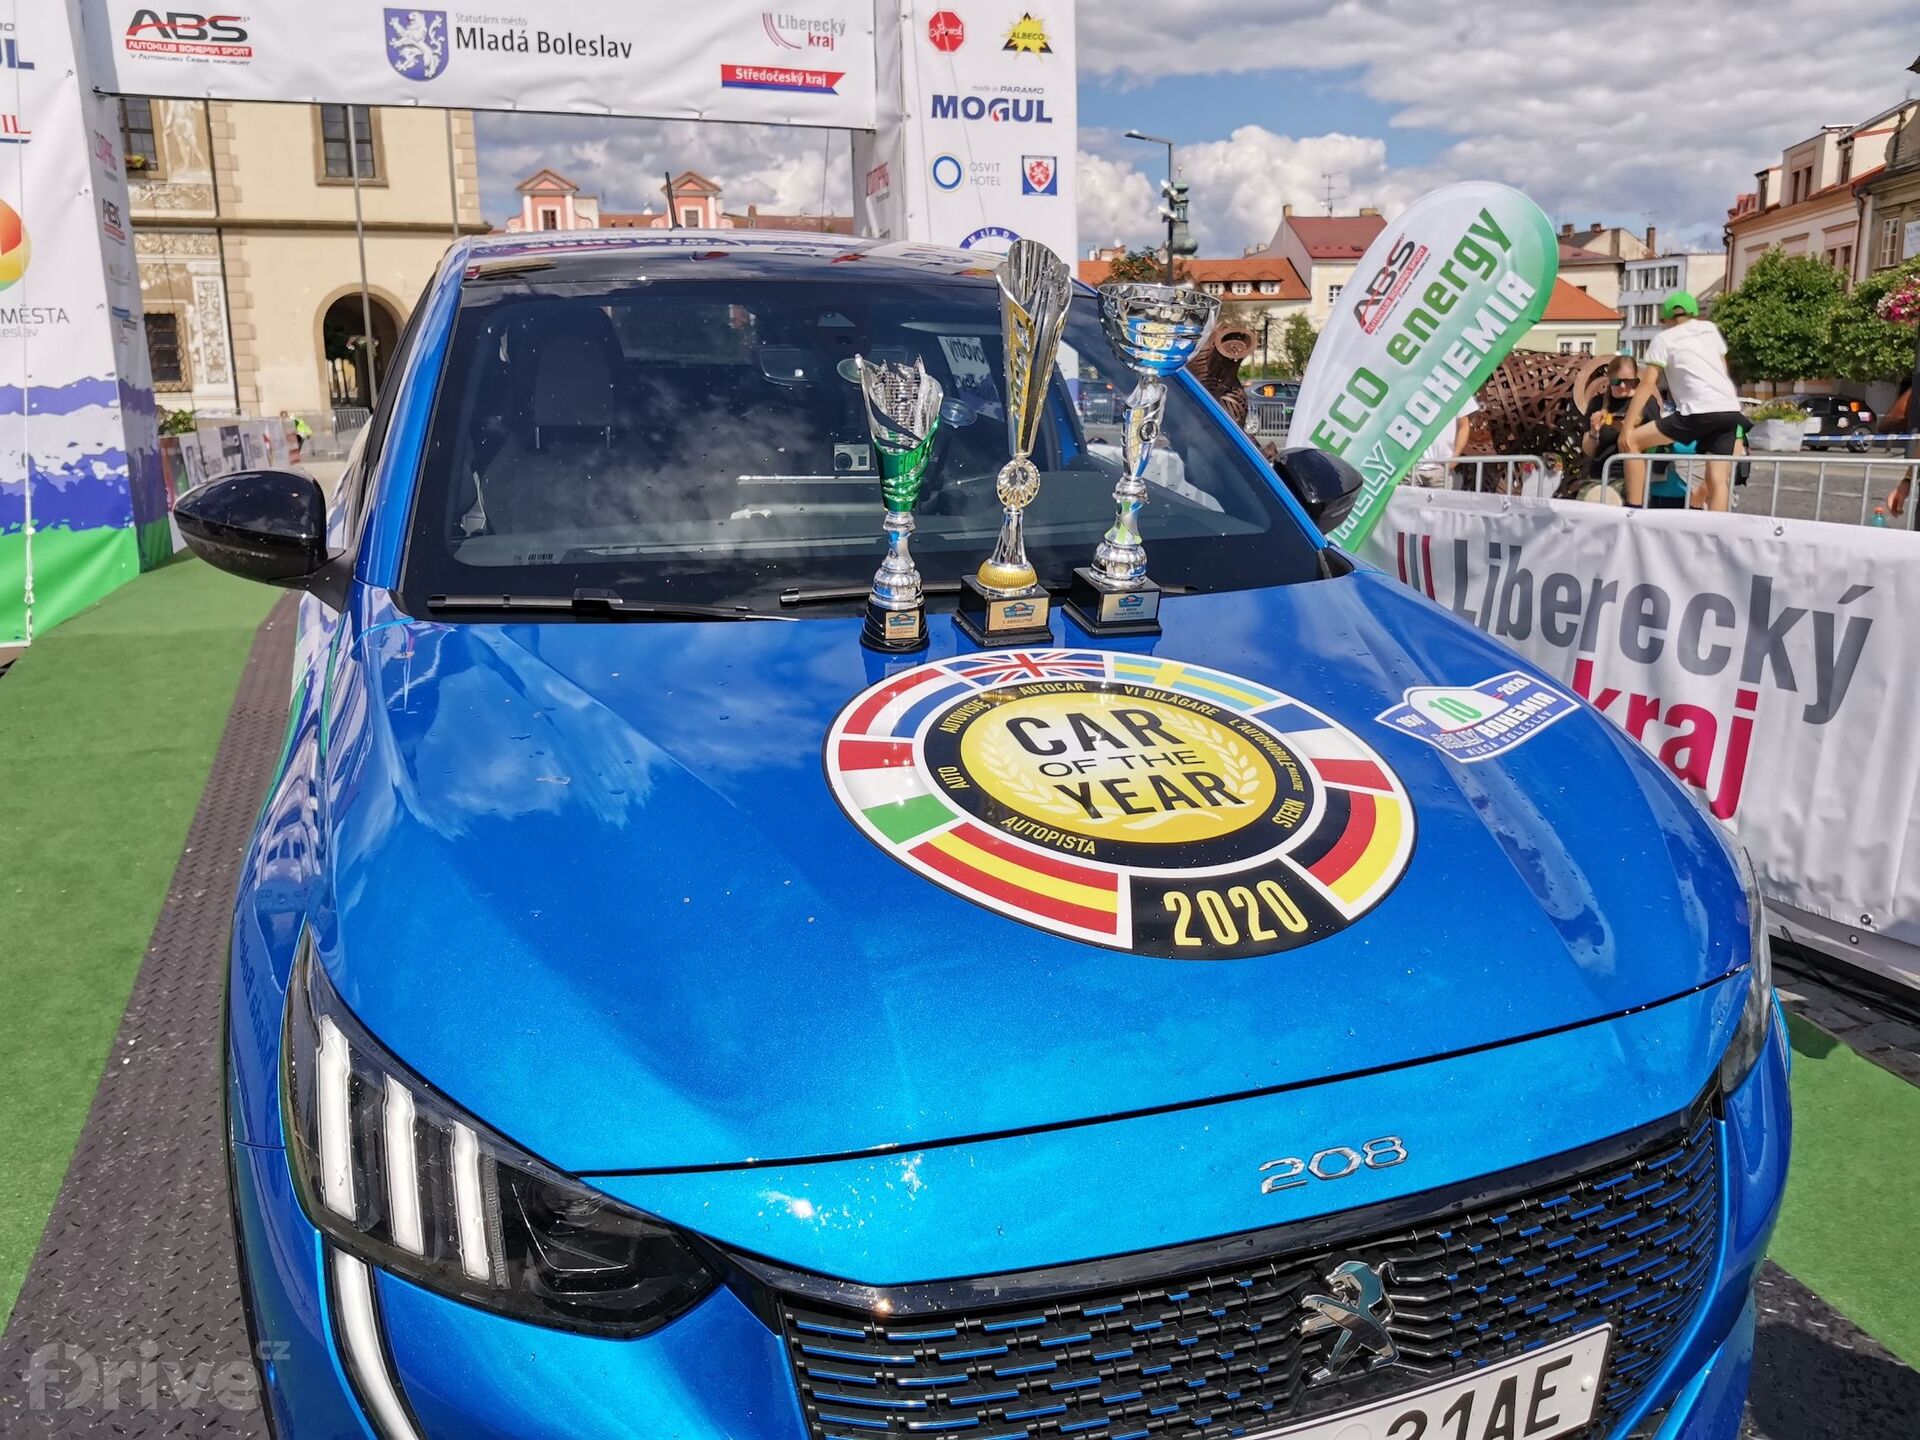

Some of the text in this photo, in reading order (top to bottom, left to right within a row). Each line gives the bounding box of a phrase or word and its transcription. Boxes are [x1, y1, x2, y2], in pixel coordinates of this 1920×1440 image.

[126, 9, 248, 42] ABS
[777, 14, 846, 37] Liberecký
[1011, 31, 1045, 41] ALBECO
[128, 41, 250, 57] AUTOKLUB BOHEMIA SPORT
[456, 26, 632, 59] Mladá Boleslav
[808, 32, 834, 52] kraj
[735, 68, 827, 88] Středočeský kraj
[1000, 86, 1044, 94] PARAMO
[931, 94, 1053, 123] MOGUL
[969, 162, 1001, 173] OSVIT
[970, 176, 1002, 187] HOTEL
[967, 229, 1022, 244] MLAD
[1354, 241, 1415, 329] ABS
[0, 303, 70, 325] MĚSTA
[1309, 367, 1389, 457] ECO
[1387, 208, 1512, 365] energy
[1385, 270, 1536, 451] BOHEMIA
[1453, 539, 1874, 725] Liberecký
[1018, 682, 1086, 696] AUTOCAR
[1124, 685, 1221, 716] VI BILÄGARE
[1497, 677, 1531, 696] 2020
[1428, 697, 1482, 723] 10
[1477, 691, 1557, 738] BOHEMIA
[1006, 708, 1186, 756] CAR
[1572, 658, 1759, 821] kraj
[938, 766, 971, 790] AUTO
[1039, 750, 1205, 777] OF THE
[1053, 771, 1246, 820] YEAR
[1272, 798, 1305, 829] STERN
[1000, 815, 1097, 855] AUTOPISTA
[1163, 879, 1309, 946] 2020
[1259, 1135, 1408, 1194] 208
